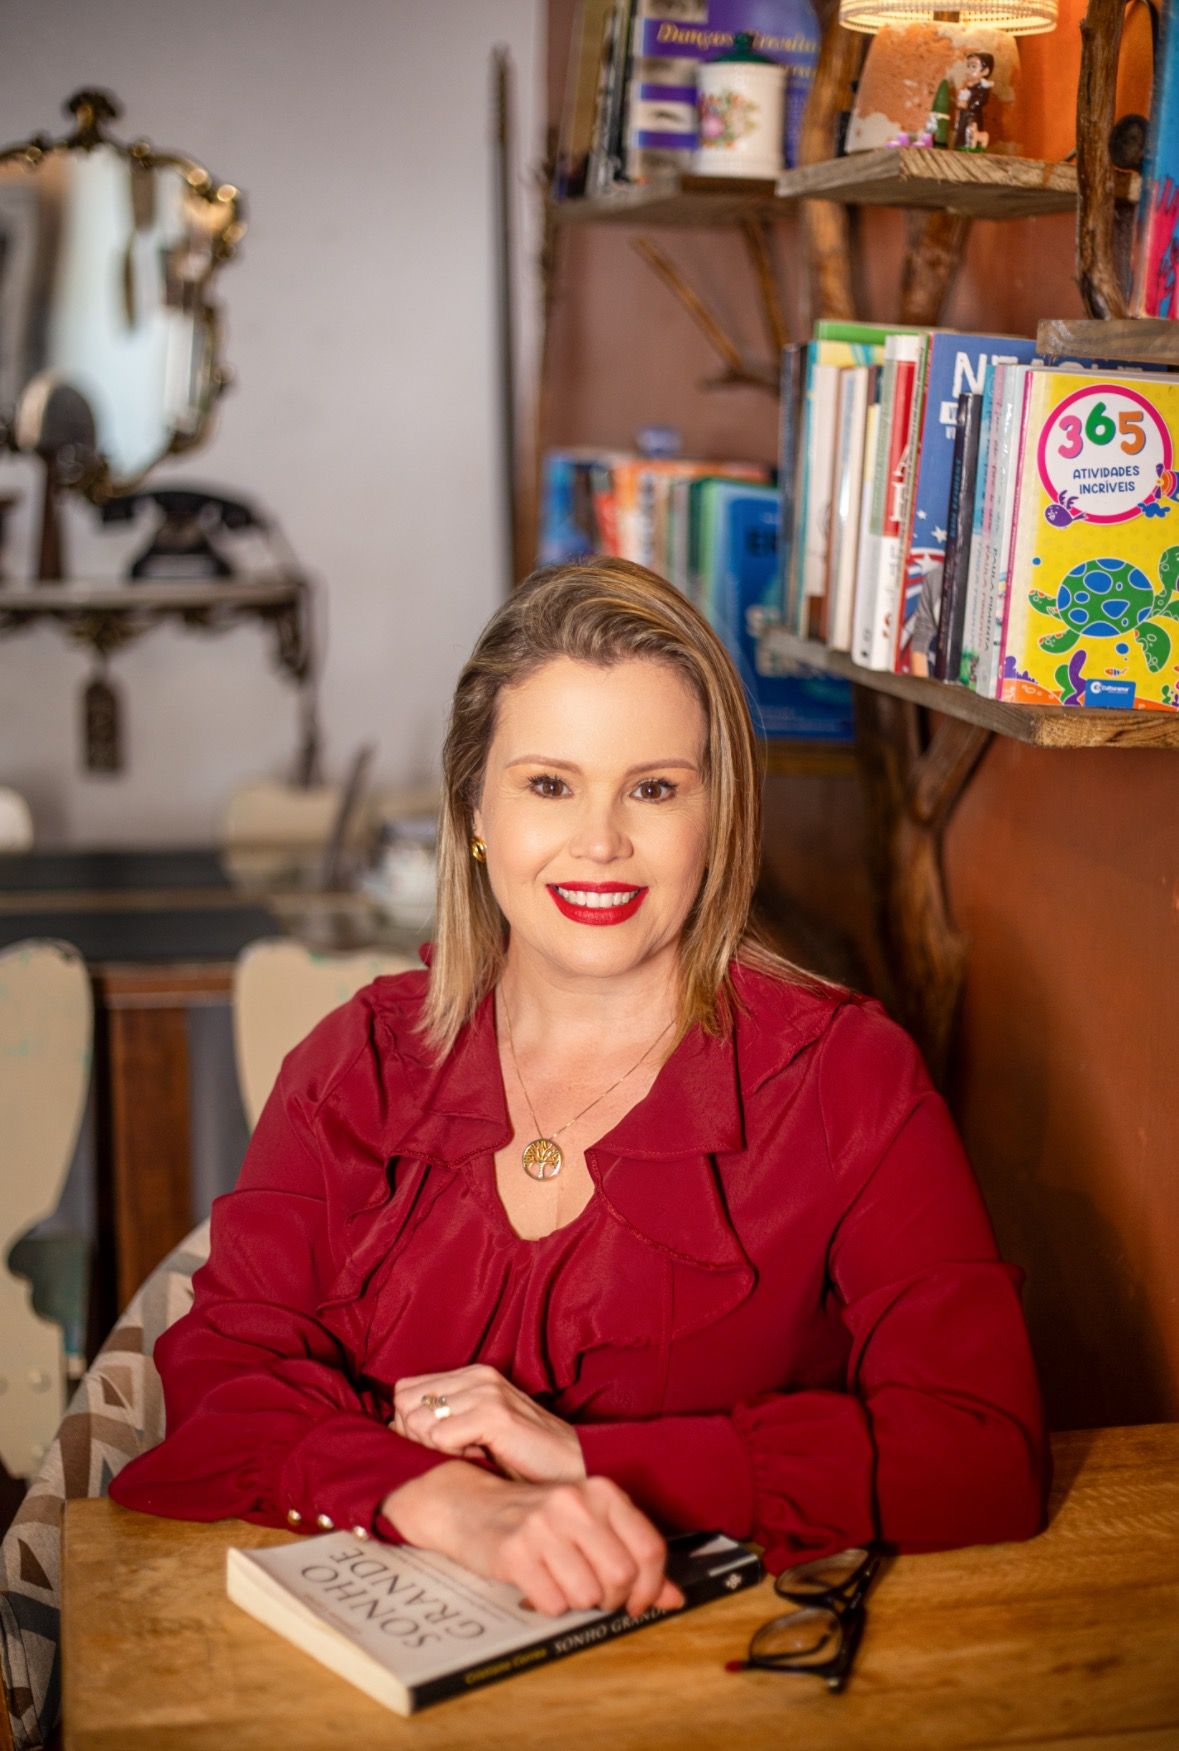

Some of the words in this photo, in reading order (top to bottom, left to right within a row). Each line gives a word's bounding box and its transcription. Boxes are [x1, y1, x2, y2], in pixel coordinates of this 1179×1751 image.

[1057, 402, 1146, 458] 365
[1073, 466, 1140, 480] ATIVIDADES
[1079, 479, 1136, 494] INCRÍVEIS
[301, 1564, 441, 1648] SONHO
[330, 1547, 486, 1639] GRANDE
[554, 1625, 607, 1653] SONHO
